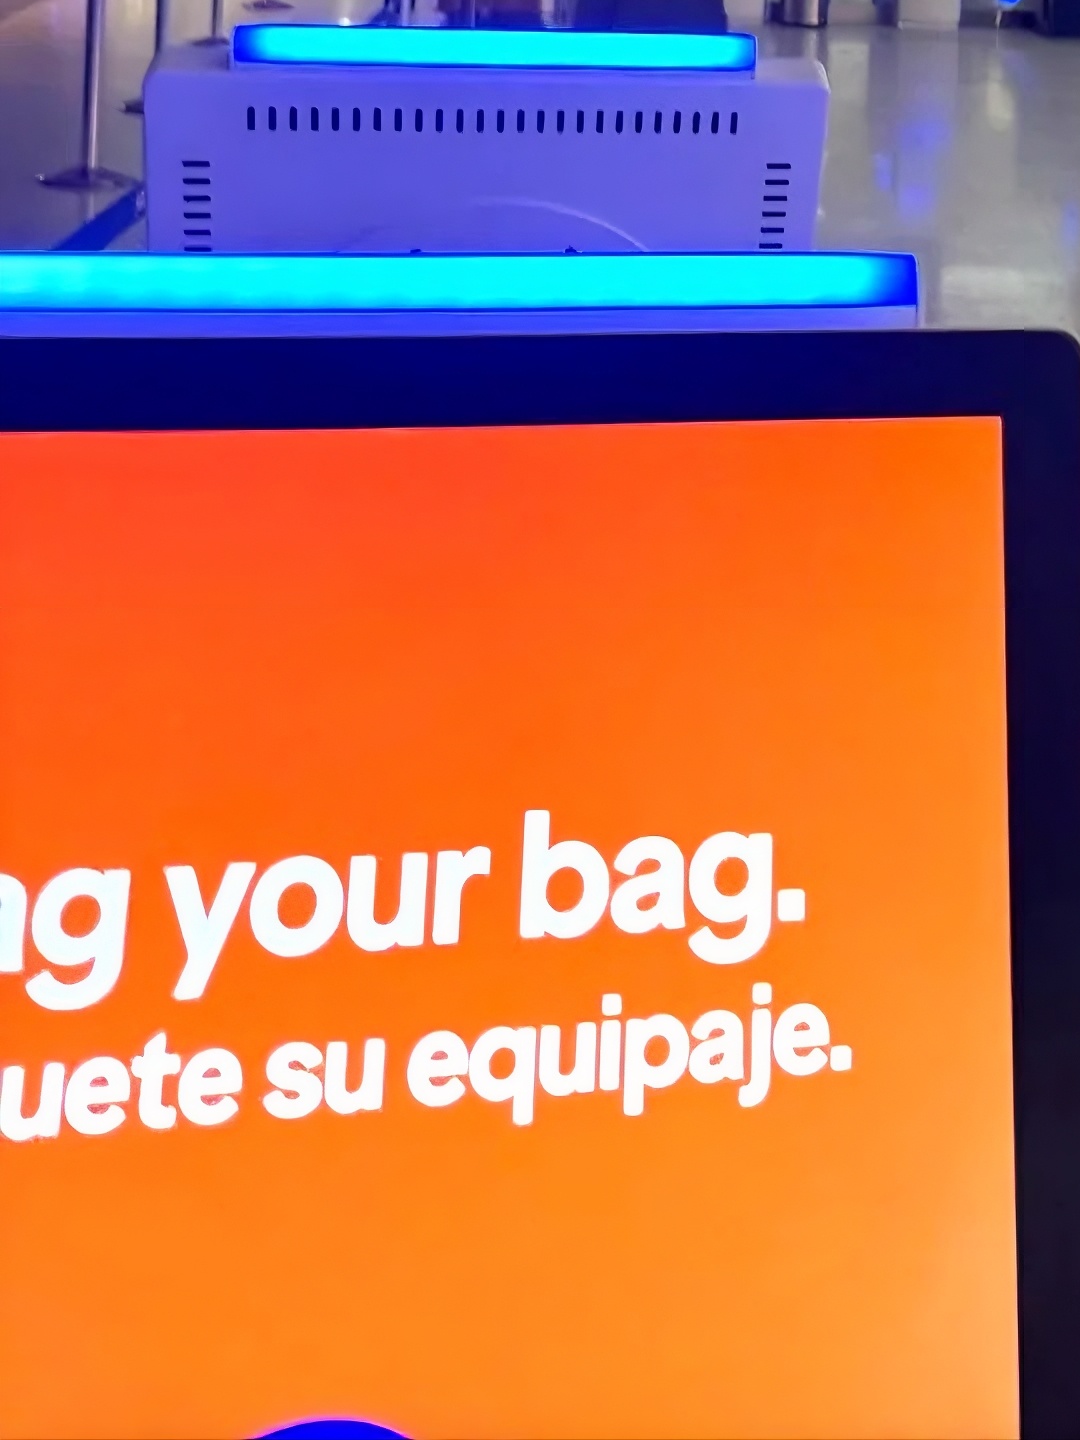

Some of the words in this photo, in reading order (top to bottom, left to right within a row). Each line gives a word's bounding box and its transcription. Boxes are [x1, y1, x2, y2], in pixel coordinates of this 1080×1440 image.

[163, 845, 492, 1002] your
[519, 809, 806, 966] bag.
[0, 1030, 244, 1143] uete
[262, 1037, 387, 1121] su
[405, 981, 854, 1128] equipaje.
